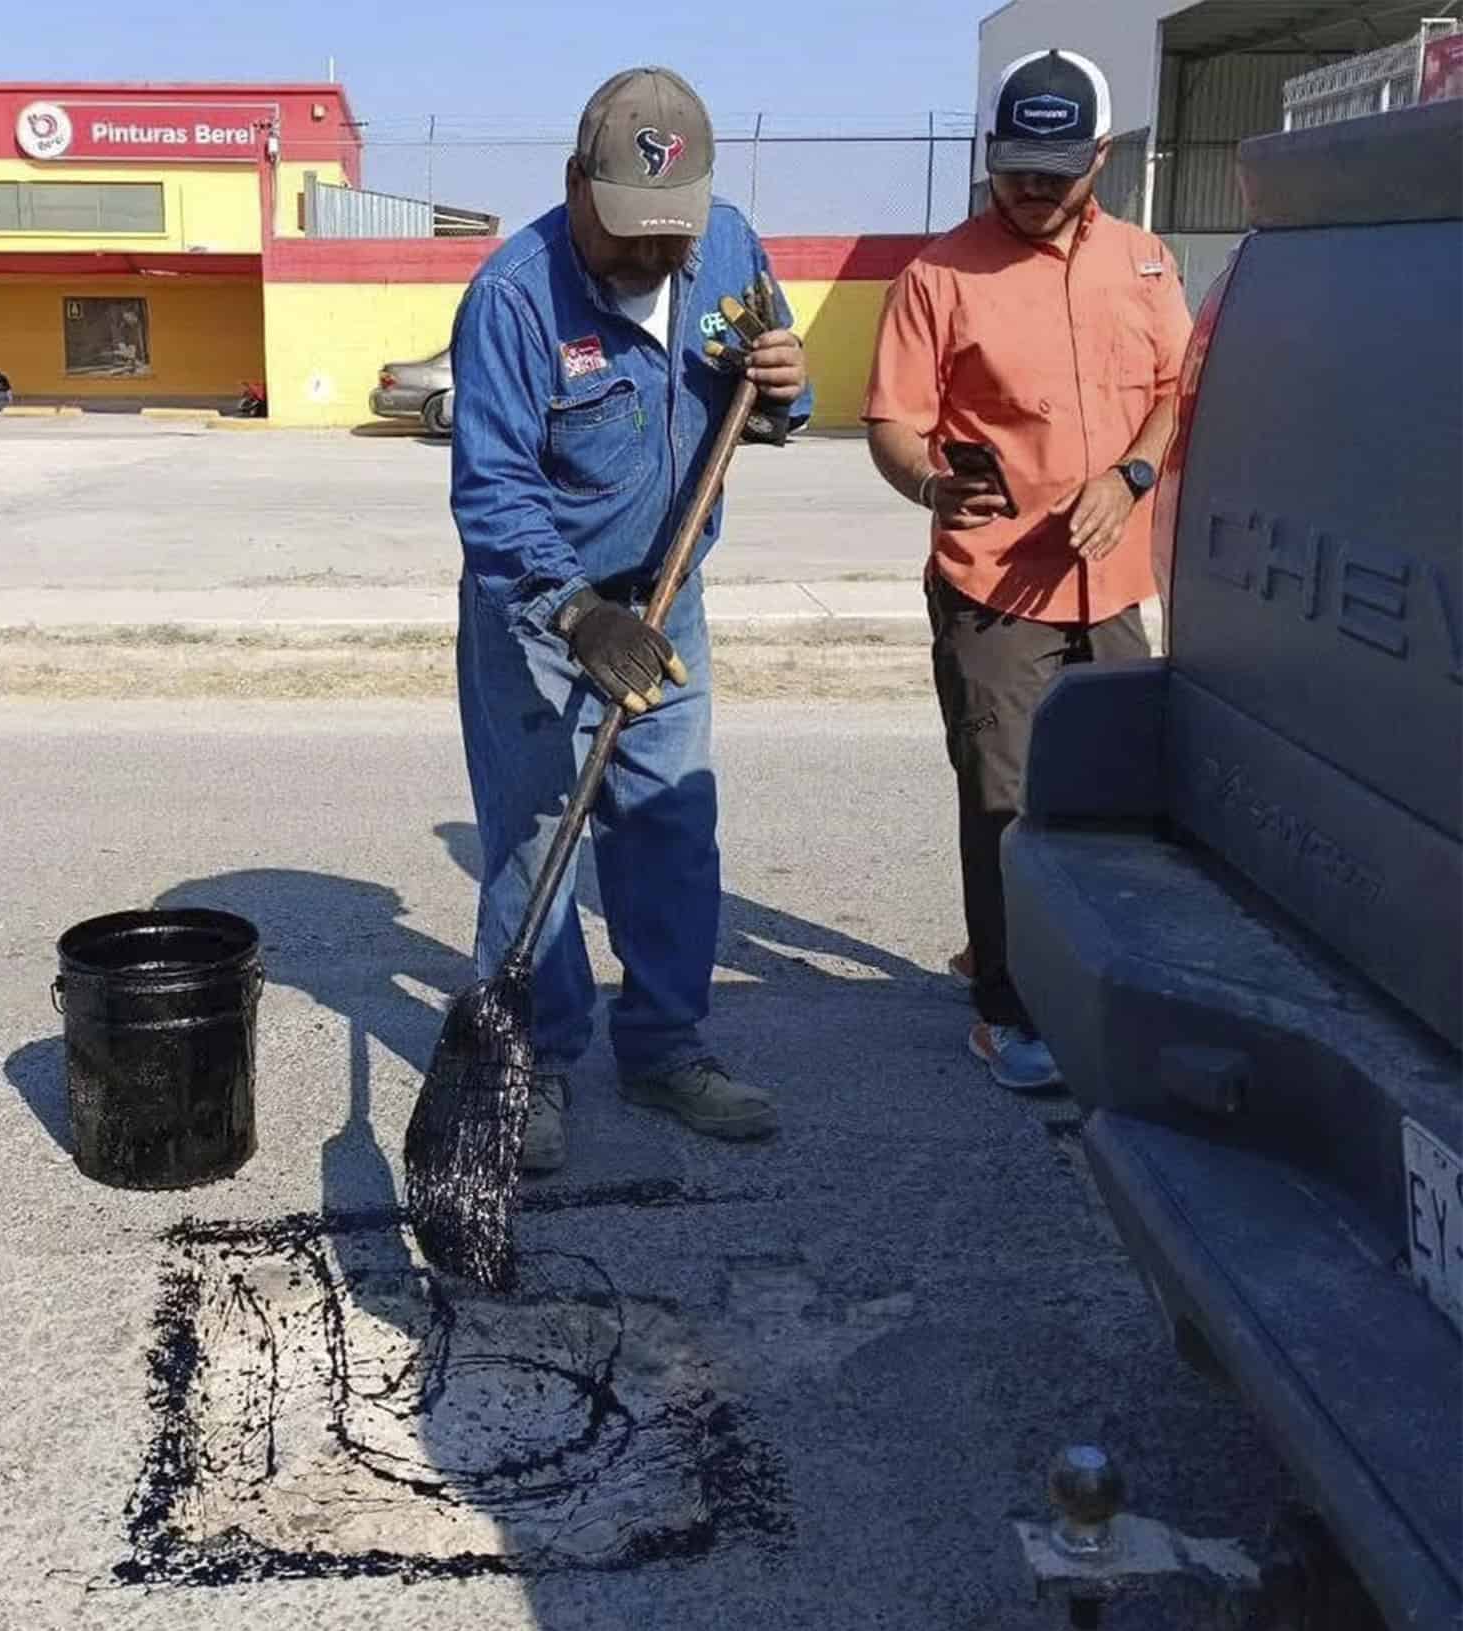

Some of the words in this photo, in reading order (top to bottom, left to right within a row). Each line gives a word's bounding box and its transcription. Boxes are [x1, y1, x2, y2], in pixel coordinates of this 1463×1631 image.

[91, 122, 189, 145] Pinturas
[194, 124, 256, 145] Berel
[1408, 1169, 1463, 1274] EY
